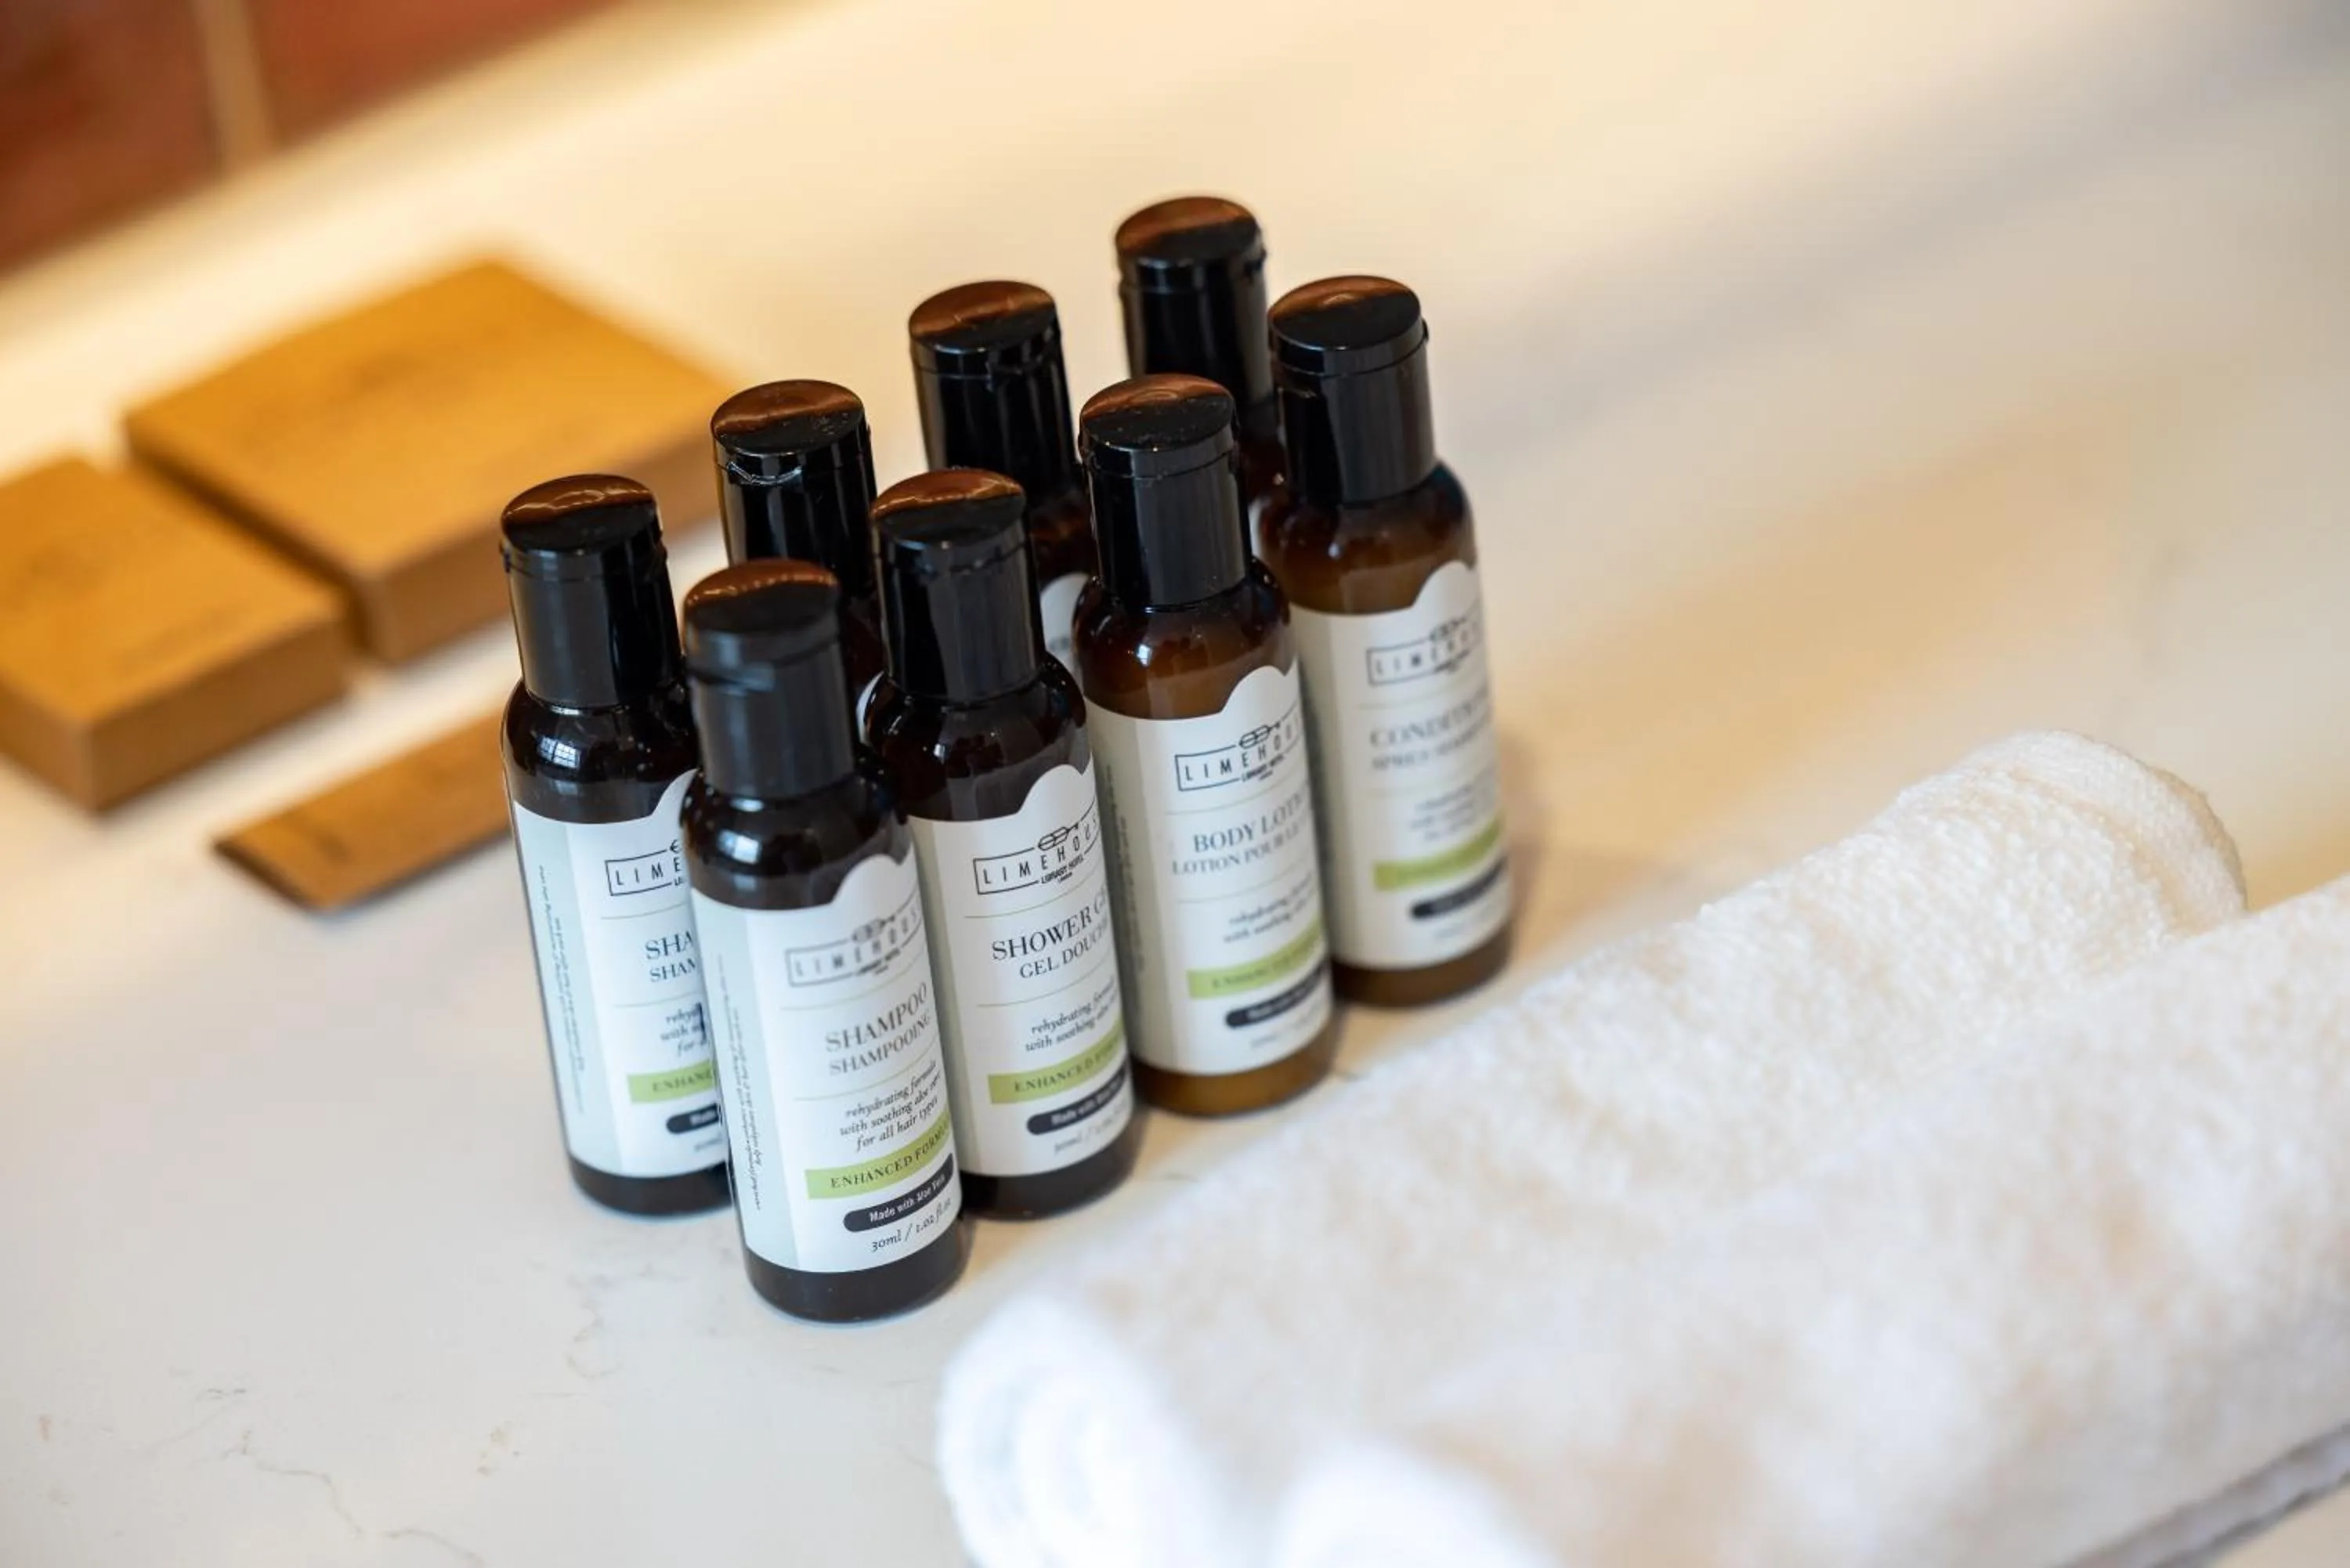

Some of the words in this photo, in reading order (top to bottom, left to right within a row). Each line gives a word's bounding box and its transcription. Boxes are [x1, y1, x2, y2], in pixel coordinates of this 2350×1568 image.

[1185, 714, 1299, 782] LIMEHOU
[1193, 821, 1256, 853] BODY
[1172, 854, 1240, 875] LOTION
[991, 905, 1093, 961] SHOWER
[1019, 956, 1060, 979] GEL
[825, 981, 927, 1053] SHAMPOO
[1025, 1035, 1052, 1052] with
[1014, 1057, 1094, 1093] ENHANCED
[846, 1086, 910, 1118] rehydrating
[840, 1119, 867, 1136] with
[856, 1134, 876, 1153] for
[879, 1123, 894, 1141] all
[897, 1114, 918, 1133] hair
[830, 1154, 913, 1188] ENHANCED
[869, 1207, 895, 1223] Made
[897, 1196, 915, 1212] with
[871, 1227, 902, 1253] 30ml
[905, 1223, 913, 1242] /
